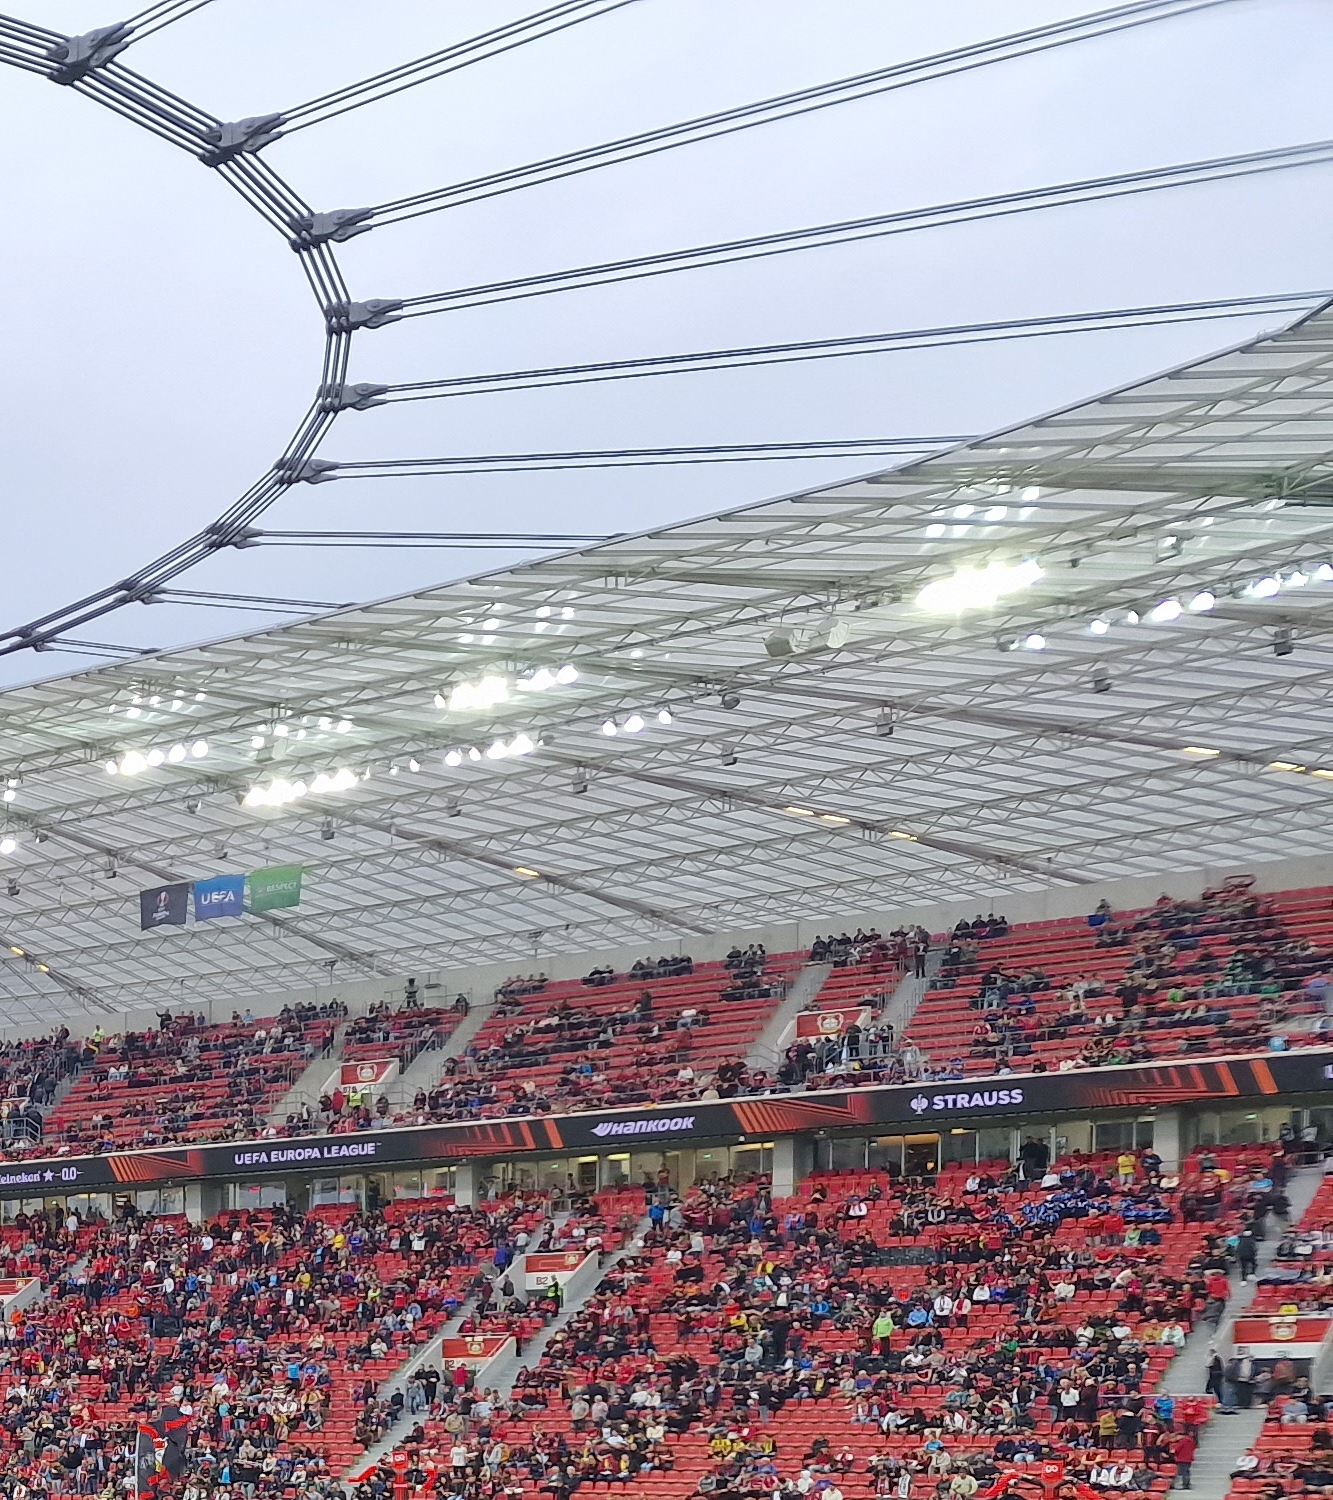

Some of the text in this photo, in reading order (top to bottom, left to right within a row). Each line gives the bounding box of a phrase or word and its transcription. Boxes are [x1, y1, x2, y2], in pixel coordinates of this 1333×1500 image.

[201, 890, 235, 905] UEFA
[932, 1089, 1024, 1111] STRAUSS
[234, 1143, 376, 1165] UEFA EUROPA LEAGUE
